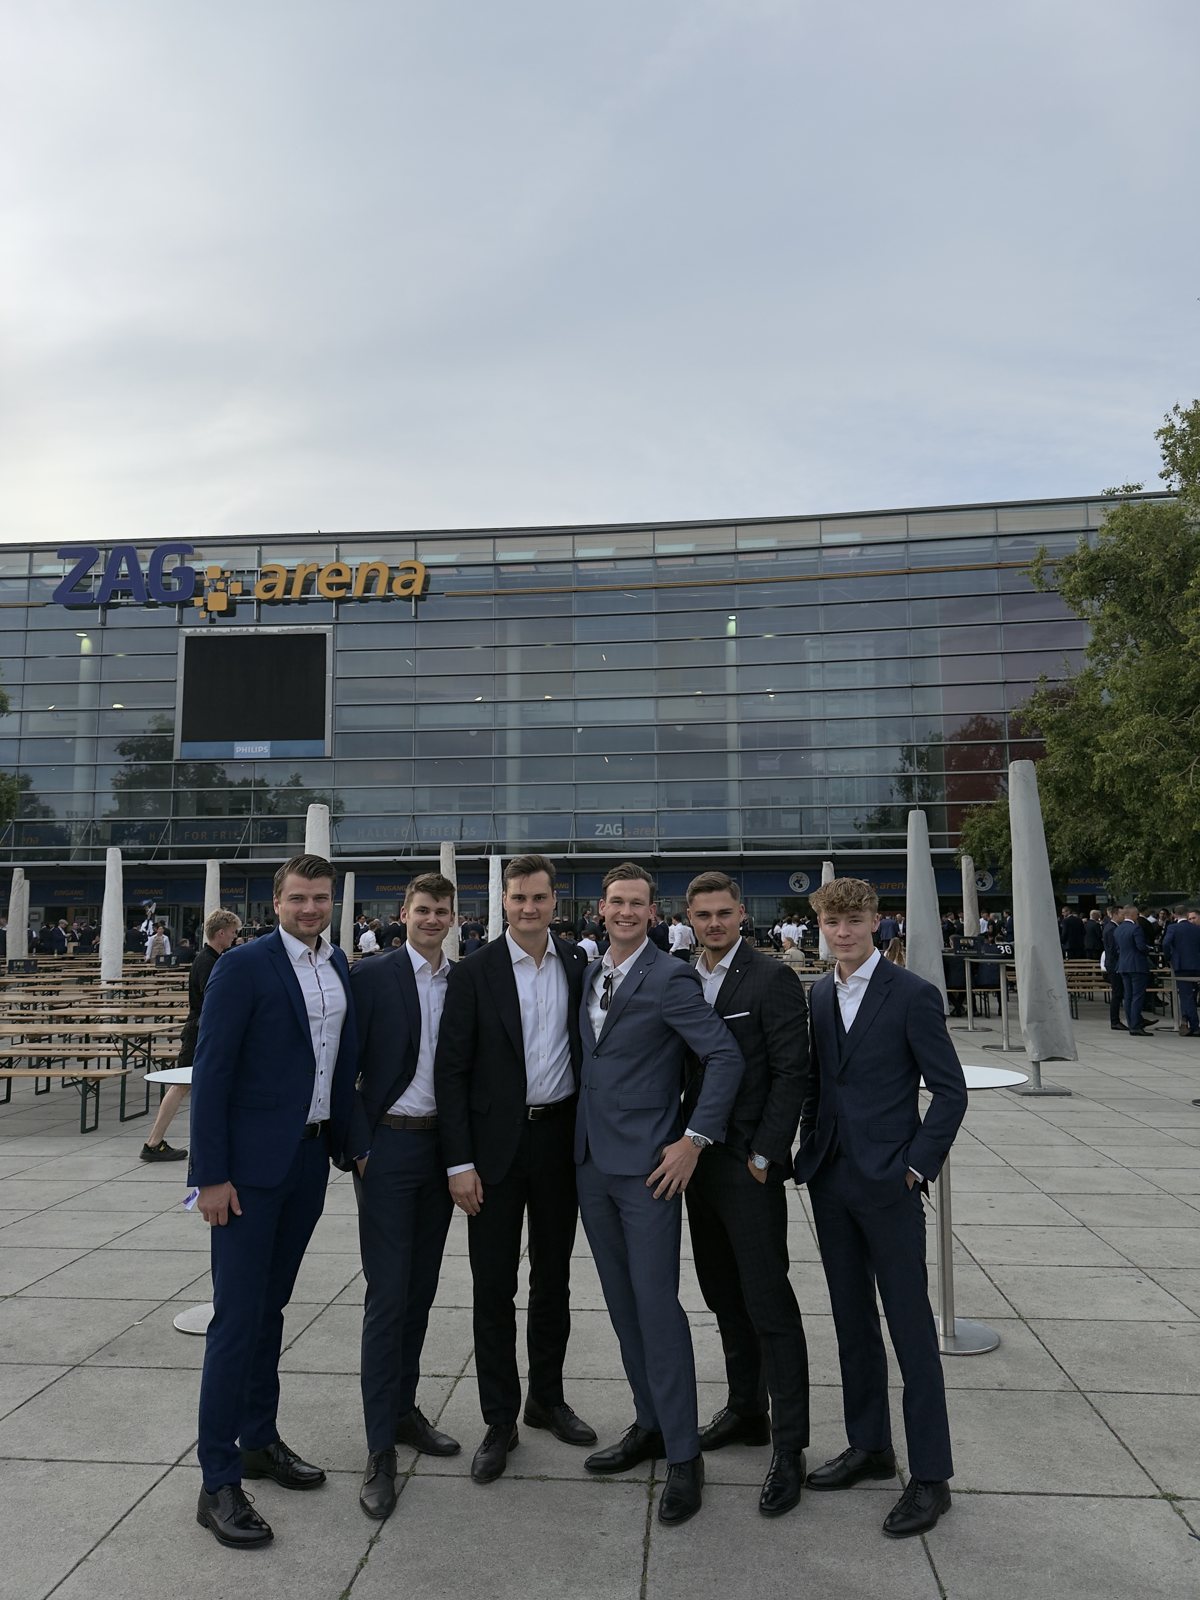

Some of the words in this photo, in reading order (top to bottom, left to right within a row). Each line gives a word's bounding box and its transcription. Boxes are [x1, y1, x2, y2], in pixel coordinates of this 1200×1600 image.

[52, 543, 195, 605] ZAG
[255, 559, 427, 601] arena
[235, 745, 270, 753] PHILIPS
[358, 827, 389, 839] HALL
[422, 825, 477, 837] FRIENDS
[594, 823, 623, 836] ZAG
